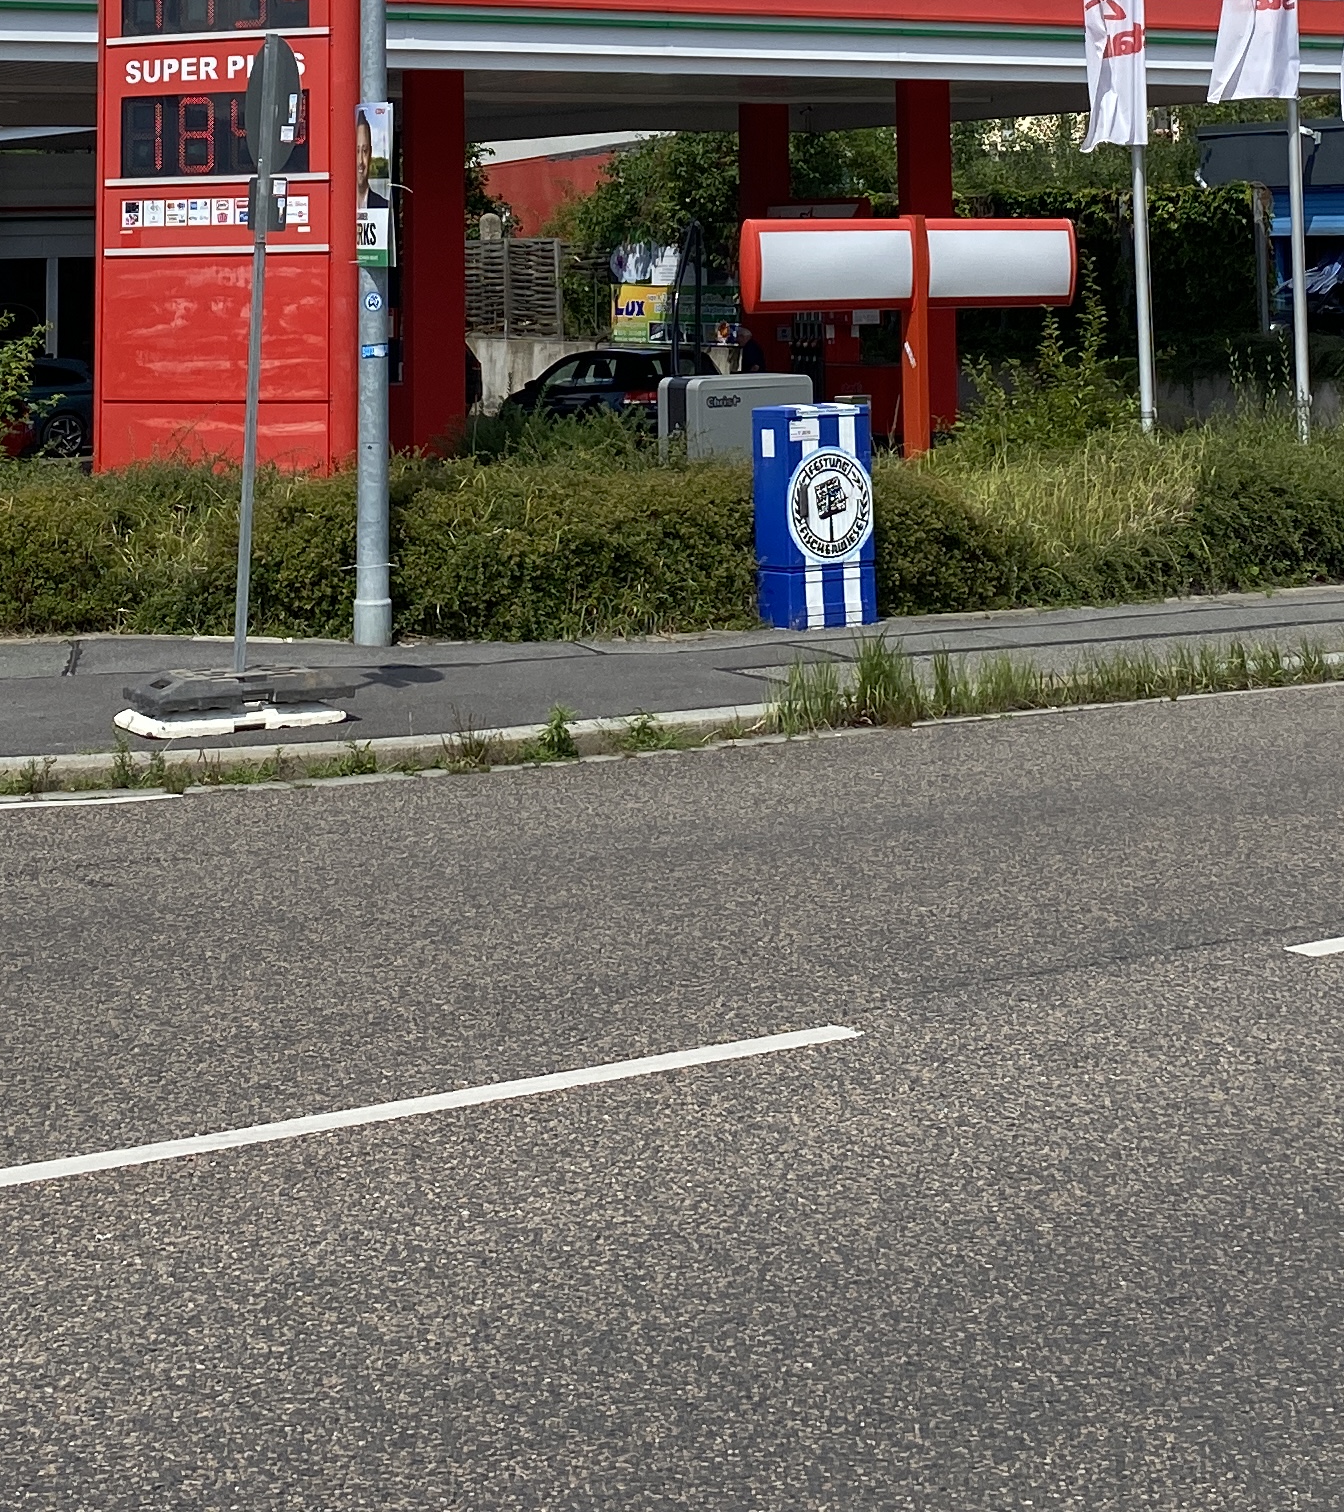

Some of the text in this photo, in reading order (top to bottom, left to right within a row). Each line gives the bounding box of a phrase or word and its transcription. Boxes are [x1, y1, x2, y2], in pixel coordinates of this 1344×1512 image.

[125, 56, 219, 85] SUPER
[707, 394, 742, 409] Christ
[808, 455, 849, 477] FESTUNG
